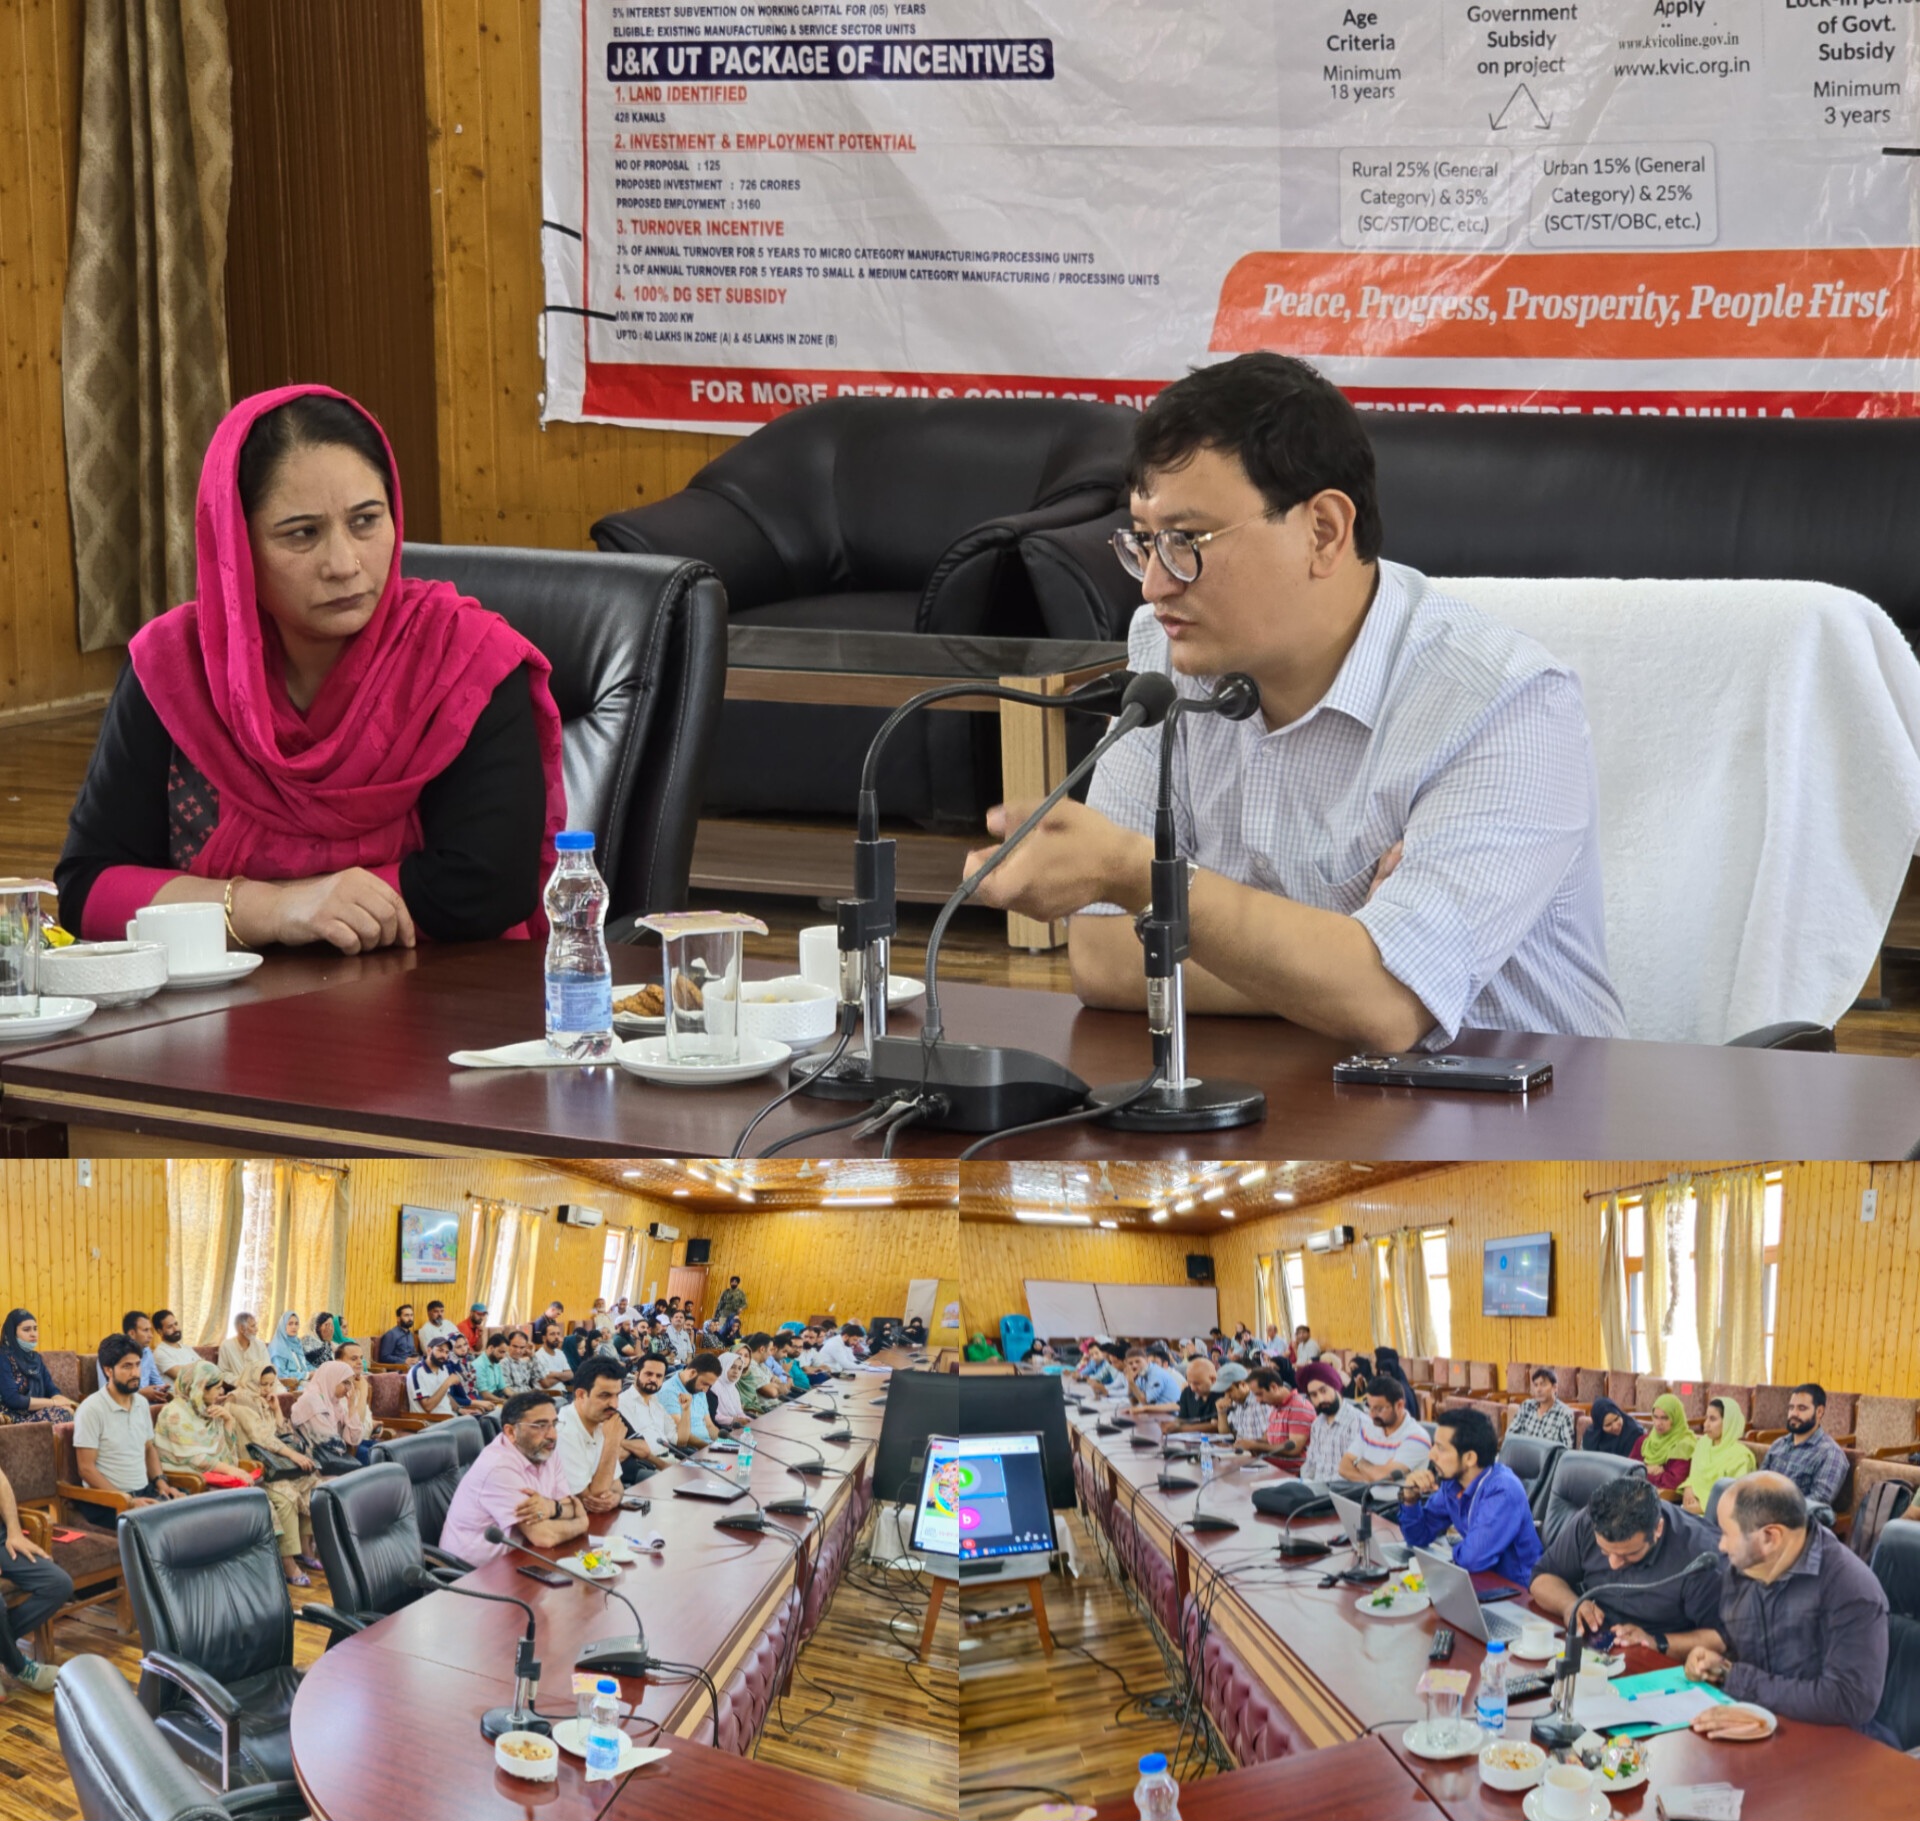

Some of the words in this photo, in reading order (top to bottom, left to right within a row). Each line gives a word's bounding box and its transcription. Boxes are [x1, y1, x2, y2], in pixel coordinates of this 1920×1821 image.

[613, 8, 624, 18] 5%
[626, 7, 671, 18] INTEREST
[674, 6, 737, 17] SUBVENTION
[740, 6, 754, 16] ON
[758, 5, 799, 16] WORKING
[801, 5, 842, 16] CAPITAL
[845, 5, 866, 15] FOR
[870, 4, 888, 18] (05)
[894, 4, 926, 15] YEARS
[1467, 4, 1578, 23] Government
[1653, 0, 1705, 17] Apply
[1342, 9, 1378, 29] Age
[1817, 15, 1838, 34] of
[1842, 14, 1896, 33] Govt.
[613, 26, 654, 37] ELIGIBLE:
[658, 26, 701, 36] EXISTING
[704, 25, 787, 36] MANUFACTURING
[790, 25, 796, 35] &
[799, 24, 837, 35] SERVICE
[841, 24, 882, 35] SECTOR
[886, 24, 916, 34] UNITS
[1326, 34, 1396, 51] Criteria
[1487, 30, 1556, 51] Subsidy
[611, 47, 659, 75] J&K
[667, 47, 702, 74] UT
[710, 46, 830, 75] PACKAGE
[837, 45, 874, 74] OF
[883, 44, 1045, 74] INCENTIVES
[1818, 42, 1895, 62] Subsidy
[1323, 65, 1401, 81] Minimum
[1477, 60, 1499, 75] on
[1504, 56, 1566, 77] project
[1614, 56, 1750, 78] www.kvic.org.in
[615, 86, 625, 101] 1.
[629, 86, 662, 101] LAND
[667, 85, 747, 101] IDENTIFIED
[1330, 85, 1349, 100] 18
[1353, 86, 1396, 103] years
[1813, 80, 1900, 98] Minimum
[615, 112, 630, 123] 428
[632, 113, 666, 123] KANALS
[1824, 107, 1836, 124] 3
[1841, 108, 1891, 128] years
[615, 133, 626, 149] 2.
[630, 134, 715, 149] INVESTMENT
[721, 134, 730, 149] &
[737, 134, 834, 149] EMPLOYMENT
[839, 134, 916, 150] POTENTIAL
[615, 160, 627, 170] NO
[630, 160, 641, 170] OF
[644, 160, 689, 171] PROPOSAL
[704, 160, 720, 171] 125
[1352, 161, 1392, 177] Rural
[1396, 161, 1430, 177] 25%
[1434, 161, 1498, 179] (General
[1543, 159, 1588, 176] Urban
[1594, 157, 1630, 174] 15%
[1635, 156, 1705, 175] (General
[615, 179, 661, 190] PROPOSED
[664, 180, 722, 190] INVESTMENT
[740, 180, 757, 190] 726
[760, 180, 801, 190] CRORES
[617, 198, 661, 209] PROPOSED
[664, 199, 726, 210] EMPLOYMENT
[737, 199, 761, 210] 3160
[1360, 189, 1436, 207] Category)
[1440, 189, 1451, 204] &
[1455, 189, 1488, 205] 35%
[1552, 185, 1635, 205] Category)
[1640, 185, 1652, 201] &
[1656, 185, 1692, 201] 25%
[616, 220, 627, 235] 3.
[631, 220, 702, 235] TURNOVER
[707, 221, 784, 236] INCENTIVE
[1457, 216, 1489, 234] etc.)
[1544, 213, 1661, 233] (SCT/ST/OBC,
[1664, 212, 1701, 231] etc.)
[631, 245, 642, 255] OF
[645, 246, 680, 257] ANNUAL
[683, 246, 734, 257] TURNOVER
[737, 247, 756, 258] FOR
[758, 247, 764, 258] 5
[767, 247, 800, 258] YEARS
[804, 248, 816, 258] TO
[820, 248, 852, 259] MICRO
[854, 248, 905, 260] CATEGORY
[1063, 252, 1095, 264] UNITS
[616, 264, 620, 275] 2
[633, 264, 645, 275] OF
[647, 265, 684, 276] ANNUAL
[686, 266, 737, 277] TURNOVER
[740, 266, 757, 277] FOR
[761, 267, 767, 277] 5
[770, 267, 803, 278] YEARS
[806, 267, 820, 278] TO
[822, 267, 855, 278] SMALL
[858, 268, 865, 279] &
[868, 268, 907, 279] MEDIUM
[909, 269, 959, 281] CATEGORY
[962, 271, 1050, 284] MANUFACTURING
[1052, 273, 1056, 284] /
[1058, 273, 1125, 285] PROCESSING
[1128, 274, 1160, 285] UNITS
[615, 285, 625, 301] 4.
[634, 286, 669, 302] 100%
[673, 286, 692, 302] DG
[697, 287, 722, 303] SET
[726, 288, 787, 304] SUBSIDY
[1259, 283, 1351, 323] Peace,
[1357, 285, 1498, 327] Progress,
[1503, 284, 1681, 328] Prosperity,
[1687, 283, 1804, 327] People
[1805, 279, 1890, 318] First
[631, 311, 644, 322] KW
[646, 311, 657, 322] TO
[659, 312, 678, 323] 2000
[680, 312, 694, 323] KW
[616, 330, 637, 340] UPTO
[644, 330, 653, 341] 40
[655, 331, 682, 341] LAKHS
[684, 332, 693, 342] IN
[695, 332, 717, 343] ZONE
[720, 332, 731, 346] (A)
[734, 332, 739, 343] &
[742, 333, 752, 344] 45
[754, 333, 784, 344] LAKHS
[787, 334, 796, 345] IN
[799, 334, 822, 345] ZONE
[825, 334, 838, 347] (B)
[690, 380, 744, 404] FOR
[751, 382, 828, 405] MORE
